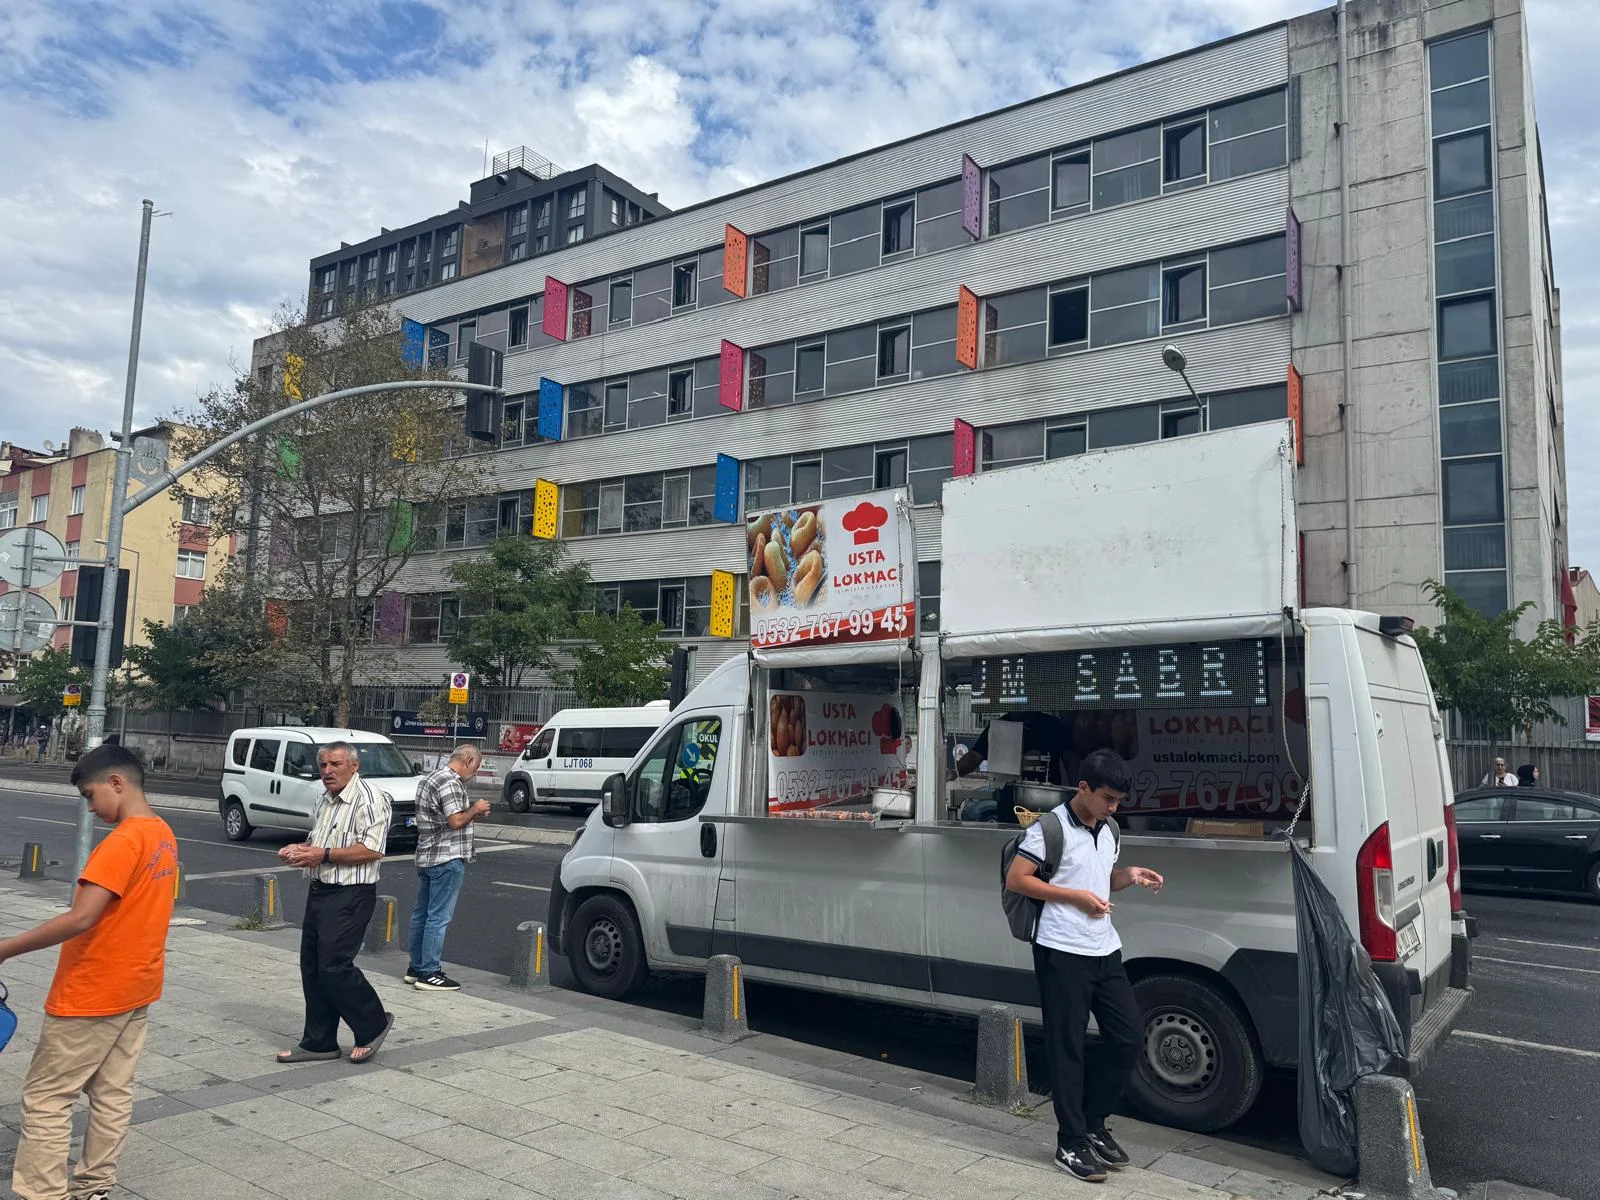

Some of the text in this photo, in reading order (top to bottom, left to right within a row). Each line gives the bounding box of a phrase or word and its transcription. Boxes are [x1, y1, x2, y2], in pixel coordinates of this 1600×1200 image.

[849, 550, 885, 566] USTA
[833, 568, 898, 588] LOKMAC
[757, 605, 908, 644] 0532 767 99 45
[822, 702, 857, 721] USTA
[1150, 716, 1274, 736] LOKMACI
[699, 733, 719, 743] OKUL
[808, 729, 871, 748] LOKMACI
[563, 758, 593, 769] LJT068
[1153, 751, 1280, 764] ustalokmaci.com
[776, 769, 821, 804] 0532
[825, 768, 856, 798] 767
[860, 767, 880, 796] 99
[1170, 771, 1242, 812] 767
